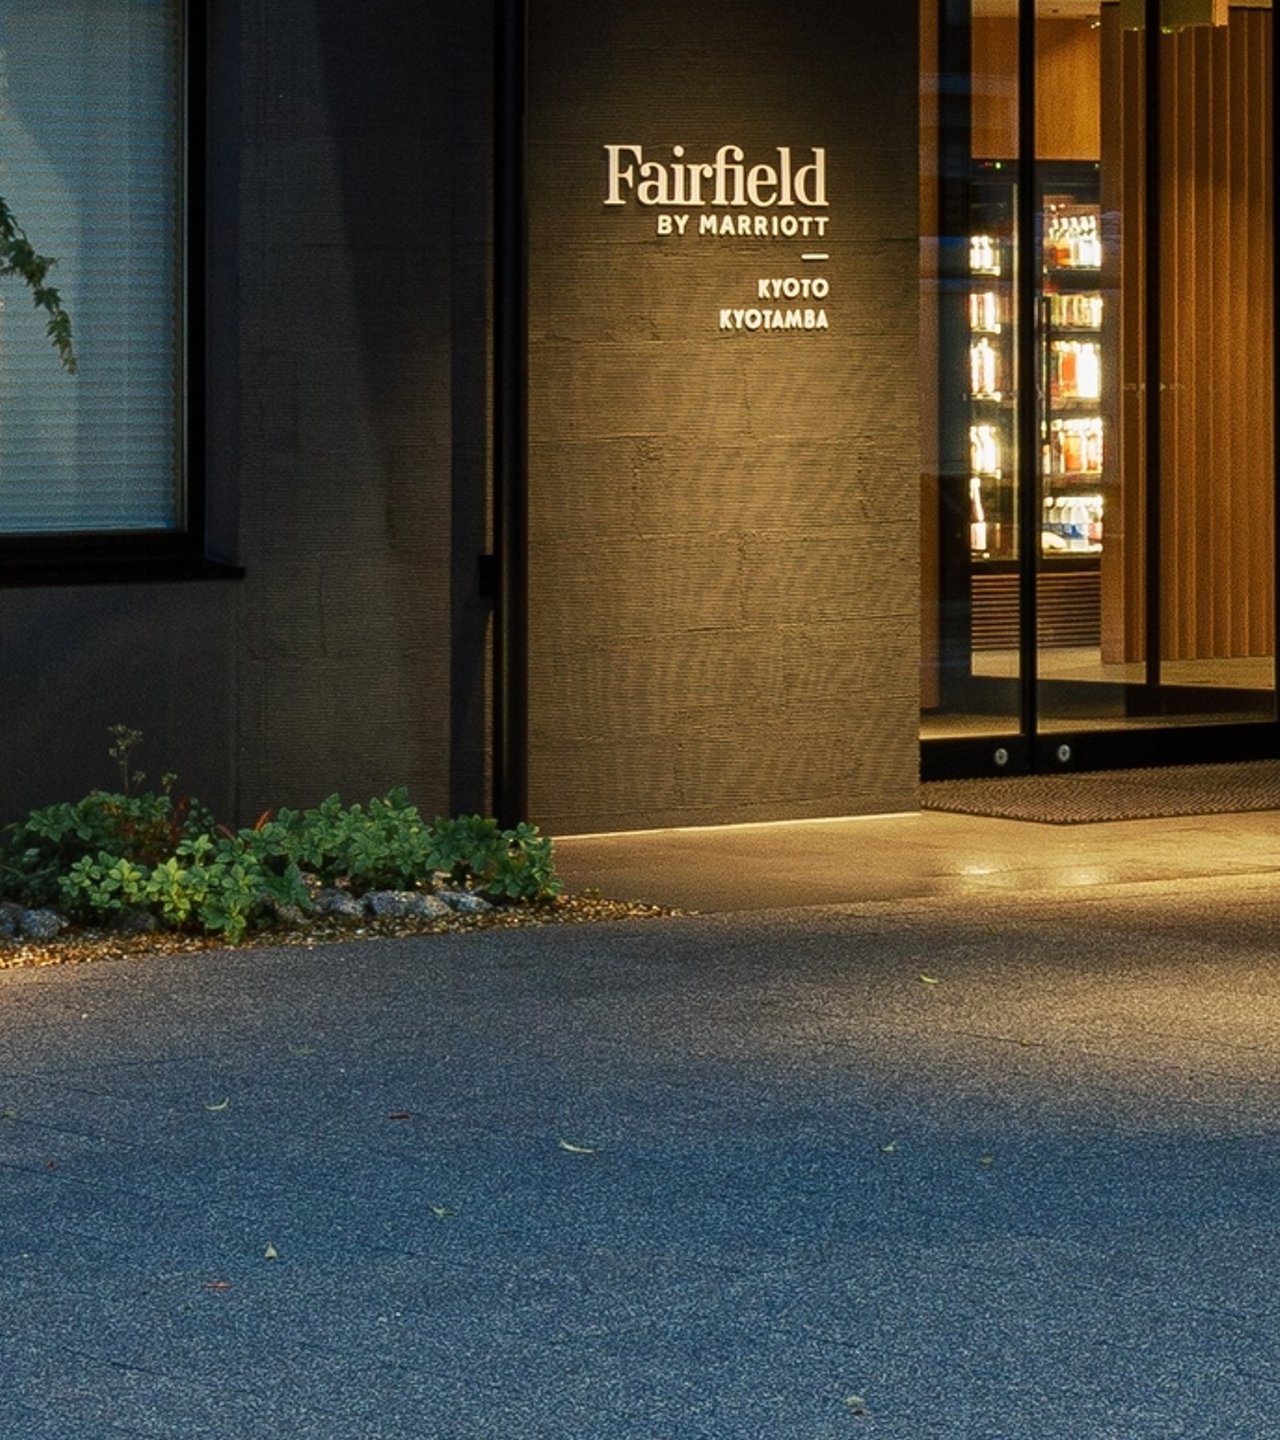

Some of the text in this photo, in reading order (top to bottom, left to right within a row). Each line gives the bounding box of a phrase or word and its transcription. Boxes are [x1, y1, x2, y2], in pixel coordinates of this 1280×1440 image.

[603, 144, 829, 207] Fairfield
[657, 214, 830, 236] BY MARRIOTT
[758, 277, 830, 299] KYOTO
[719, 308, 829, 329] KYOTAMBA
